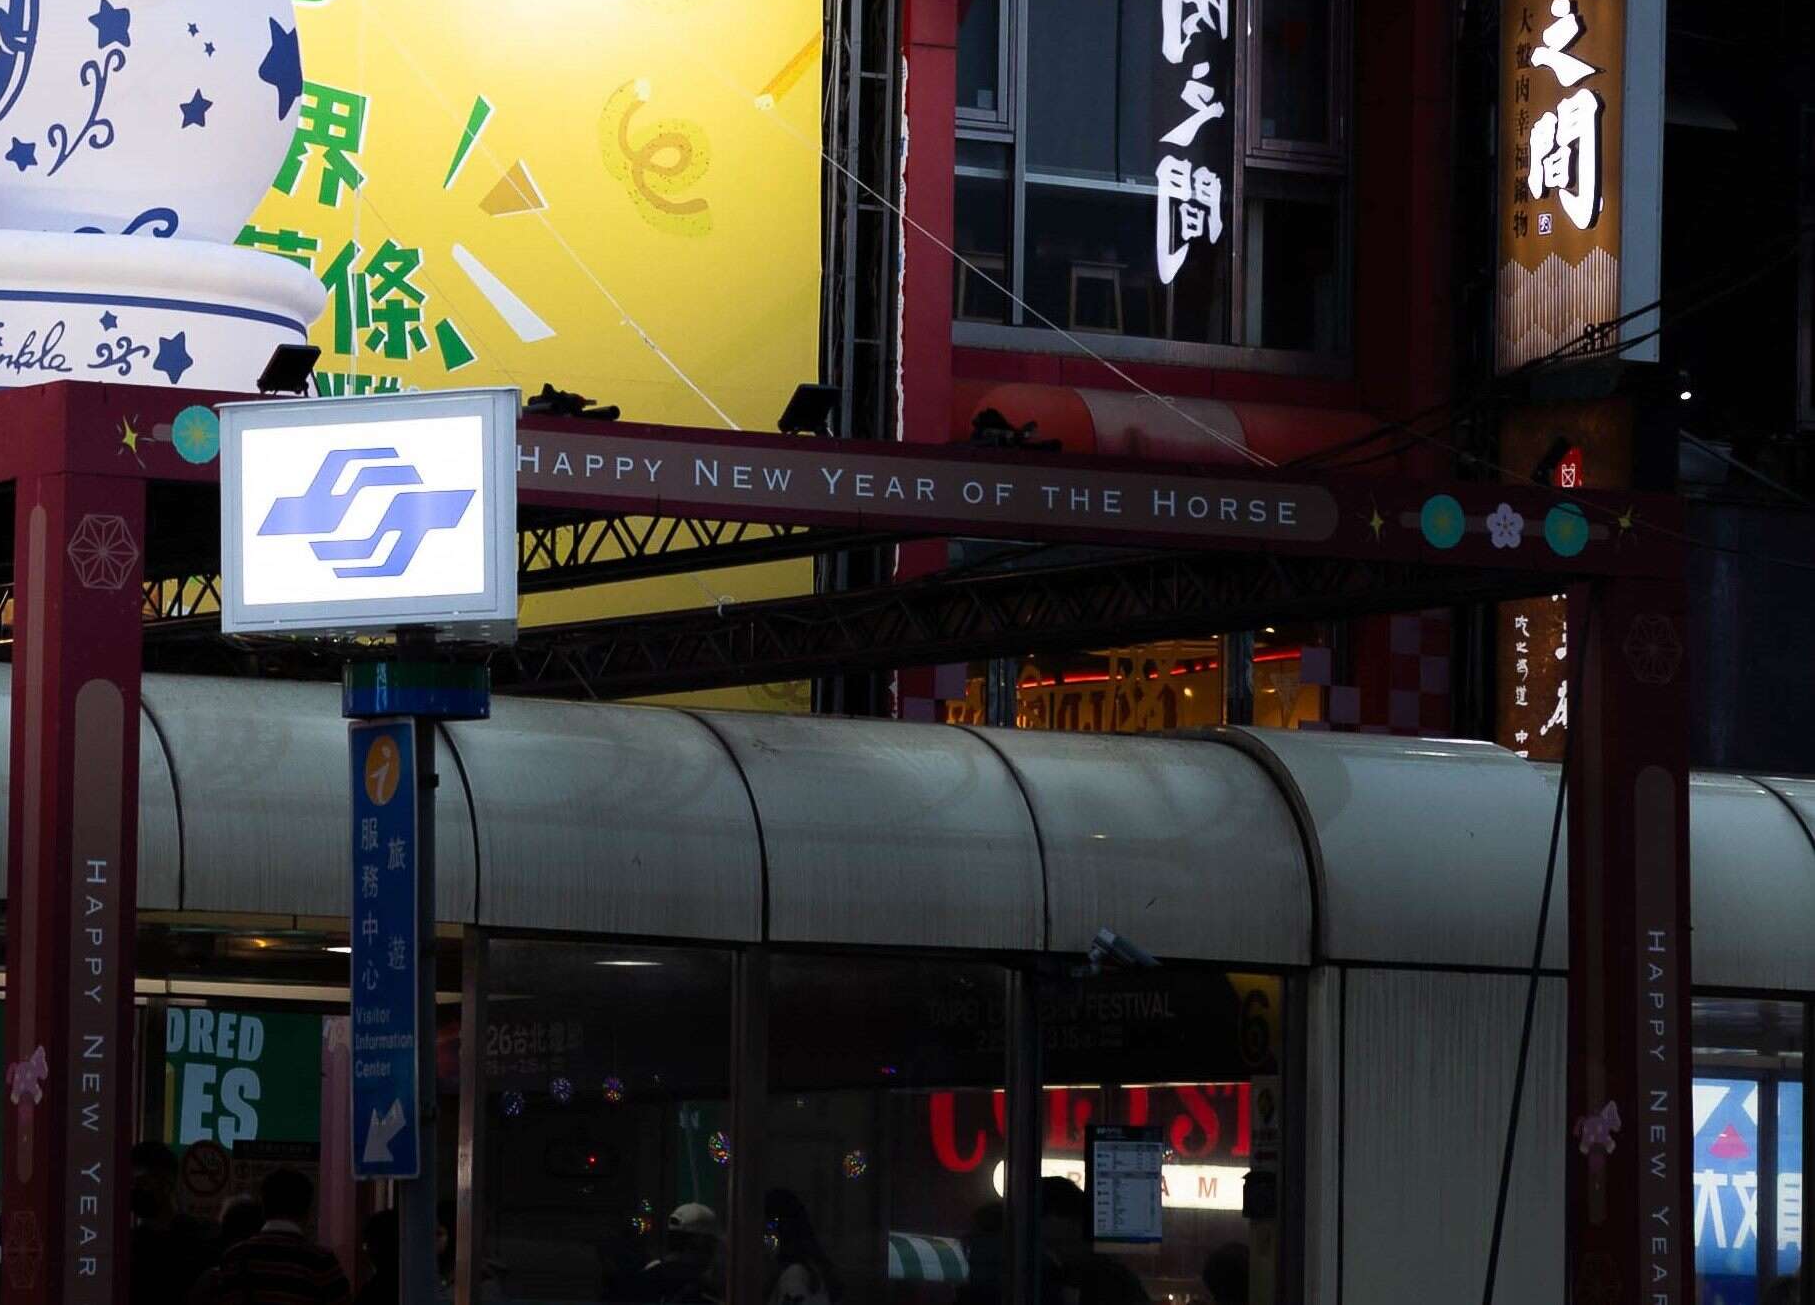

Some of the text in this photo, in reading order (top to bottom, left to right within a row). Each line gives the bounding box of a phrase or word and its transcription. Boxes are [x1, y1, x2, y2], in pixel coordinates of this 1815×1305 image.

[516, 444, 1299, 527] HAPPY NEW YEAR OF THE HORSE
[1648, 930, 1667, 1062] HAPPY
[78, 859, 108, 1276] HAPPY NEW YEAR
[1650, 1091, 1668, 1179] NEW
